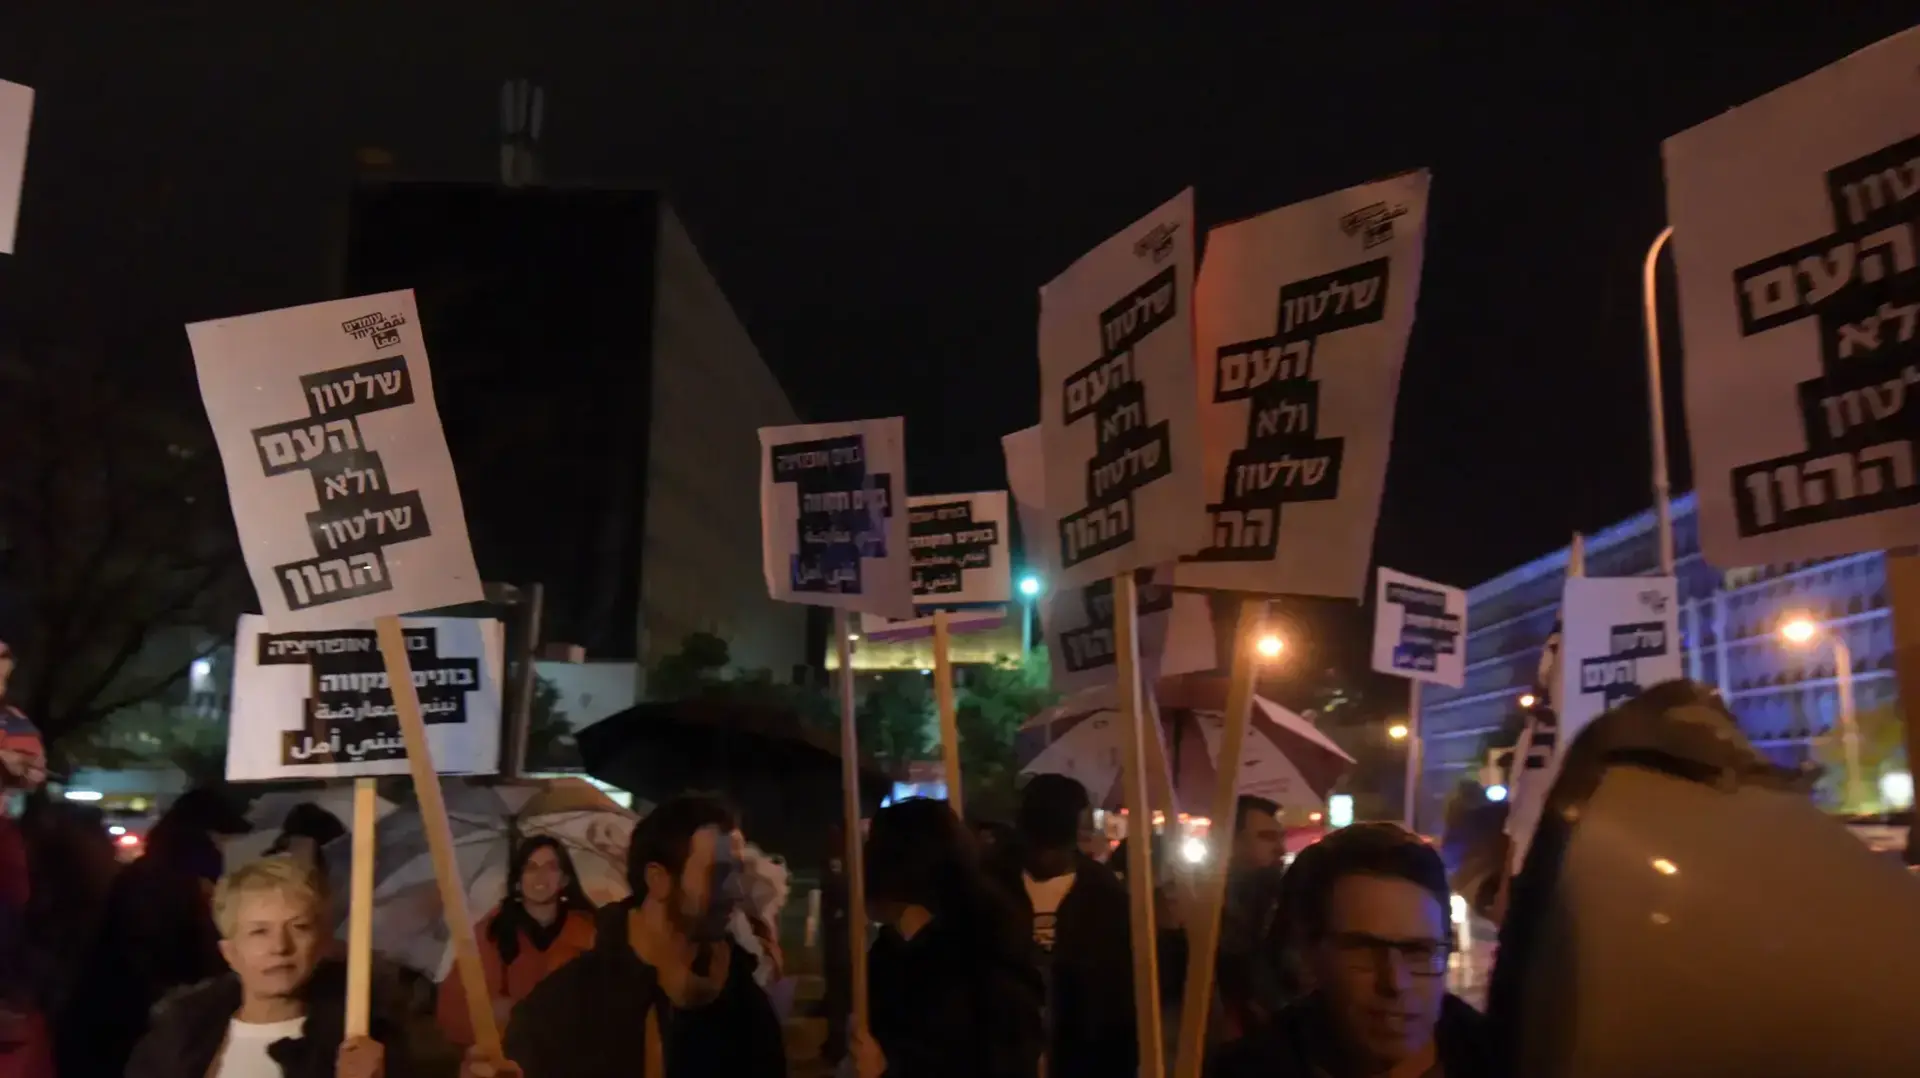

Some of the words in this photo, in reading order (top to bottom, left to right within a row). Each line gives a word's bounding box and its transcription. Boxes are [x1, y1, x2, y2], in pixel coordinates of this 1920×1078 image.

[1841, 156, 1920, 224] טון
[1743, 222, 1915, 321] העם
[1105, 281, 1172, 350] שלטון
[1283, 276, 1381, 333] שלטון
[1838, 302, 1920, 358] לא
[310, 369, 402, 415] שלטון
[1066, 352, 1131, 414] העם
[1219, 339, 1310, 392] העם
[260, 418, 360, 467] העם
[1103, 402, 1140, 443] ולא
[1256, 399, 1308, 438] ולא
[324, 467, 380, 500] ולא
[1093, 439, 1161, 497] שלטון
[1235, 454, 1331, 497] שלטון
[1745, 440, 1915, 527] ההון
[320, 506, 412, 549] שלטון
[1064, 498, 1129, 560] ההון
[1214, 508, 1275, 548] הה
[285, 552, 382, 604] ההון
